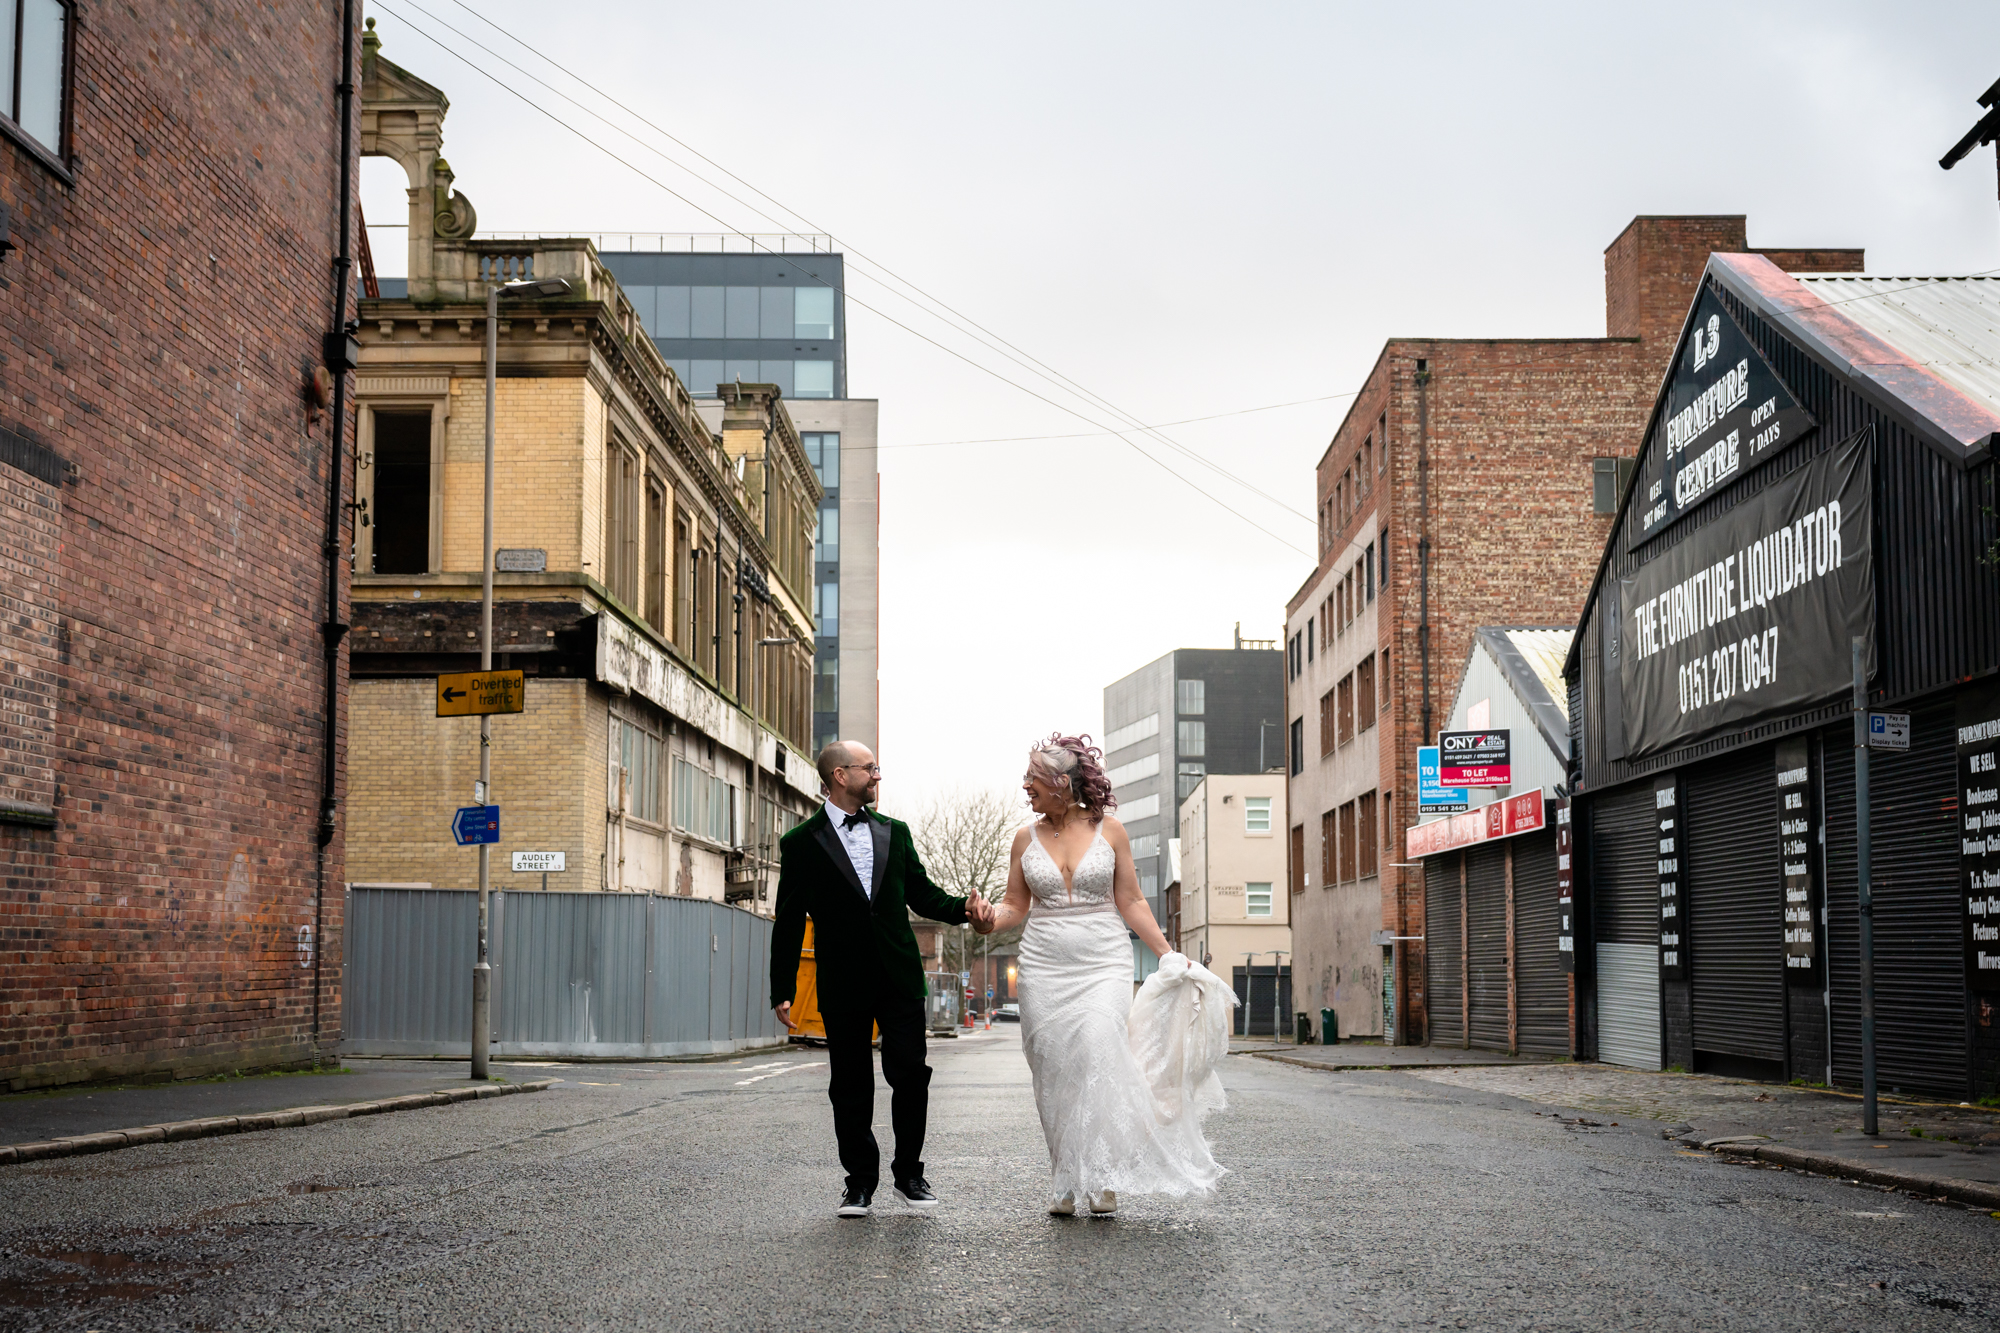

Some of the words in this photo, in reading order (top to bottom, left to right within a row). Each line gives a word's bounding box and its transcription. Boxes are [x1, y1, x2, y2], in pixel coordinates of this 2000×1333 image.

[1693, 314, 1720, 373] L3
[1666, 358, 1748, 460] FURNITURE
[1751, 396, 1776, 428] OPEN
[1749, 438, 1755, 456] 7
[1757, 421, 1780, 452] DAYS
[1675, 428, 1740, 509] CENTRE
[1649, 479, 1662, 502] 0151
[1643, 510, 1653, 531] 207
[1654, 499, 1667, 523] 0647
[1634, 597, 1659, 661] THE
[1659, 554, 1736, 649] FURNITURE
[1739, 500, 1842, 612] LIQUIDATOR
[1678, 655, 1709, 714] 0151
[1712, 642, 1738, 703] 207
[1741, 626, 1778, 692] 0647
[471, 677, 521, 690] Diverted
[479, 693, 513, 705] traffic
[1444, 735, 1487, 750] ONYX
[1421, 766, 1434, 776] TO
[1462, 769, 1472, 777] TO
[1473, 769, 1488, 777] LET
[1969, 754, 1980, 774] WE
[1981, 752, 1996, 772] SELL
[1778, 767, 1808, 788] FURNITURE
[1784, 794, 1792, 810] WE
[1792, 792, 1803, 809] SELL
[1966, 786, 1998, 806] Bookcases
[1795, 818, 1808, 833] Chairs
[1965, 813, 1981, 833] Lamp
[1794, 839, 1807, 854] Suites
[1962, 836, 1986, 857] Dinning
[1970, 871, 1982, 889] T.v.
[1786, 887, 1808, 902] Sideboards
[1785, 907, 1797, 923] Coffee
[1797, 907, 1810, 922] Tables
[1968, 896, 1987, 919] Funky
[1799, 928, 1812, 943] Tables
[1972, 922, 1998, 941] Pictures
[1786, 952, 1800, 968] Corner
[1800, 953, 1811, 968] units
